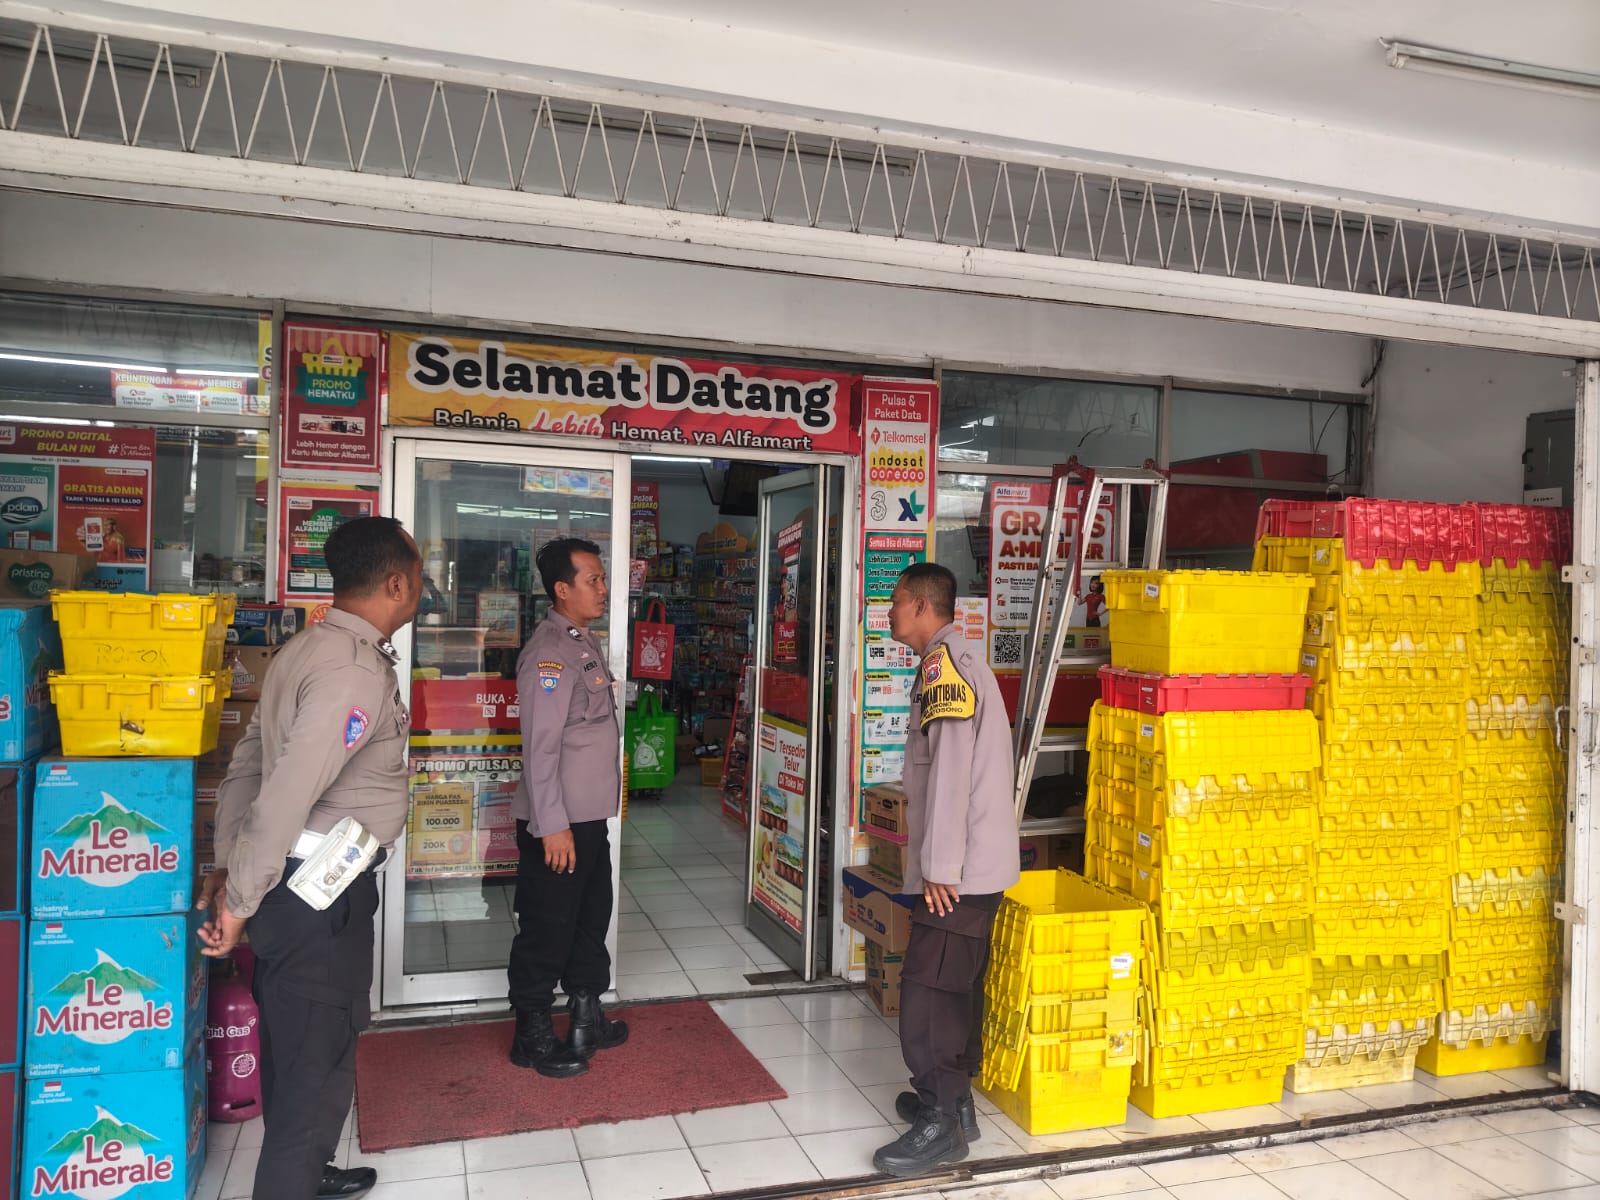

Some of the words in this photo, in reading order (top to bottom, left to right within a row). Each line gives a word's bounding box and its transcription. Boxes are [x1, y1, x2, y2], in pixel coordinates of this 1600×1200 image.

[115, 373, 172, 385] KEUNTUNGAN
[312, 379, 352, 390] PROMO
[413, 341, 644, 403] Selamat
[655, 358, 833, 428] Datang
[308, 389, 355, 400] HEMATKU
[882, 393, 907, 406] Pulsa
[908, 394, 916, 407] &
[875, 408, 900, 419] Paket
[901, 409, 922, 420] Data
[20, 428, 64, 439] PROMO
[67, 431, 112, 442] DIGITAL
[434, 409, 520, 431] Belanja
[532, 410, 603, 437] Lebih
[722, 430, 812, 451] Alfamart
[883, 431, 926, 444] Telkomsel
[37, 442, 77, 453] BULAN
[80, 444, 96, 453] INI
[296, 440, 315, 448] Lebih
[316, 441, 339, 449] Hemat
[340, 443, 366, 452] dengan
[312, 450, 340, 458] Member
[341, 451, 370, 460] Alfamart
[872, 455, 923, 467] indosat
[871, 469, 924, 481] ooredoo
[64, 484, 104, 494] GRATIS
[106, 485, 144, 495] ADMIN
[996, 488, 1029, 497] Alfamart
[8, 503, 39, 514] pdam
[868, 538, 886, 547] Semua
[902, 538, 923, 548] Alfamart
[998, 562, 1025, 570] PASTI
[11, 568, 50, 579] pristine
[476, 693, 505, 704] BUKA
[779, 740, 806, 760] Tersedia
[416, 760, 466, 772] PROMO
[468, 759, 509, 771] PULSA
[511, 761, 521, 770] &
[783, 755, 800, 773] Telur
[425, 817, 460, 826] 100.000
[91, 821, 128, 850] Le
[423, 841, 446, 849] 200K
[40, 844, 178, 877] Minerale
[86, 979, 123, 1007] Le
[36, 1001, 171, 1034] Minerale
[226, 1026, 250, 1038] Gas
[85, 1135, 123, 1164] Le
[33, 1155, 172, 1195] Minerale
